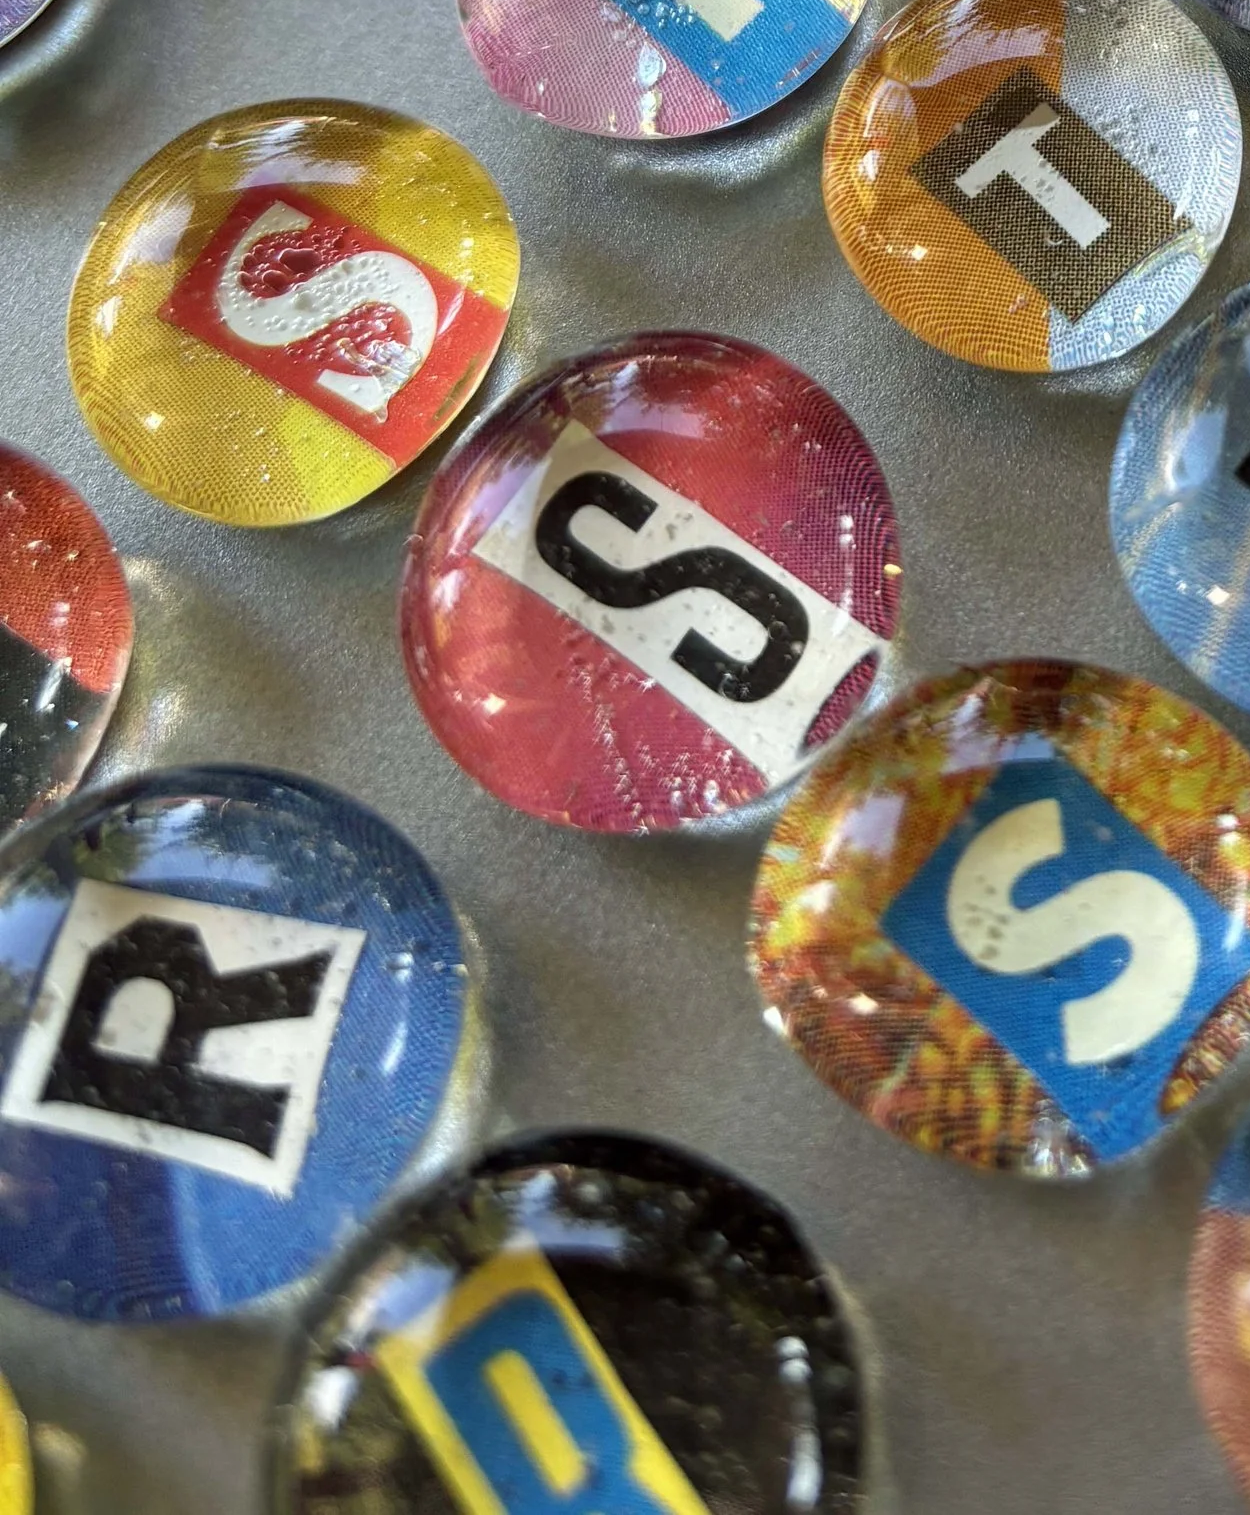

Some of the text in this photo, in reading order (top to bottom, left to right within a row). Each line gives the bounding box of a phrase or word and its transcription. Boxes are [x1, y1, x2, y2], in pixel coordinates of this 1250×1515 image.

[954, 101, 1111, 250] T
[535, 470, 810, 704] S
[40, 915, 338, 1161] R
[946, 798, 1199, 1066] S
